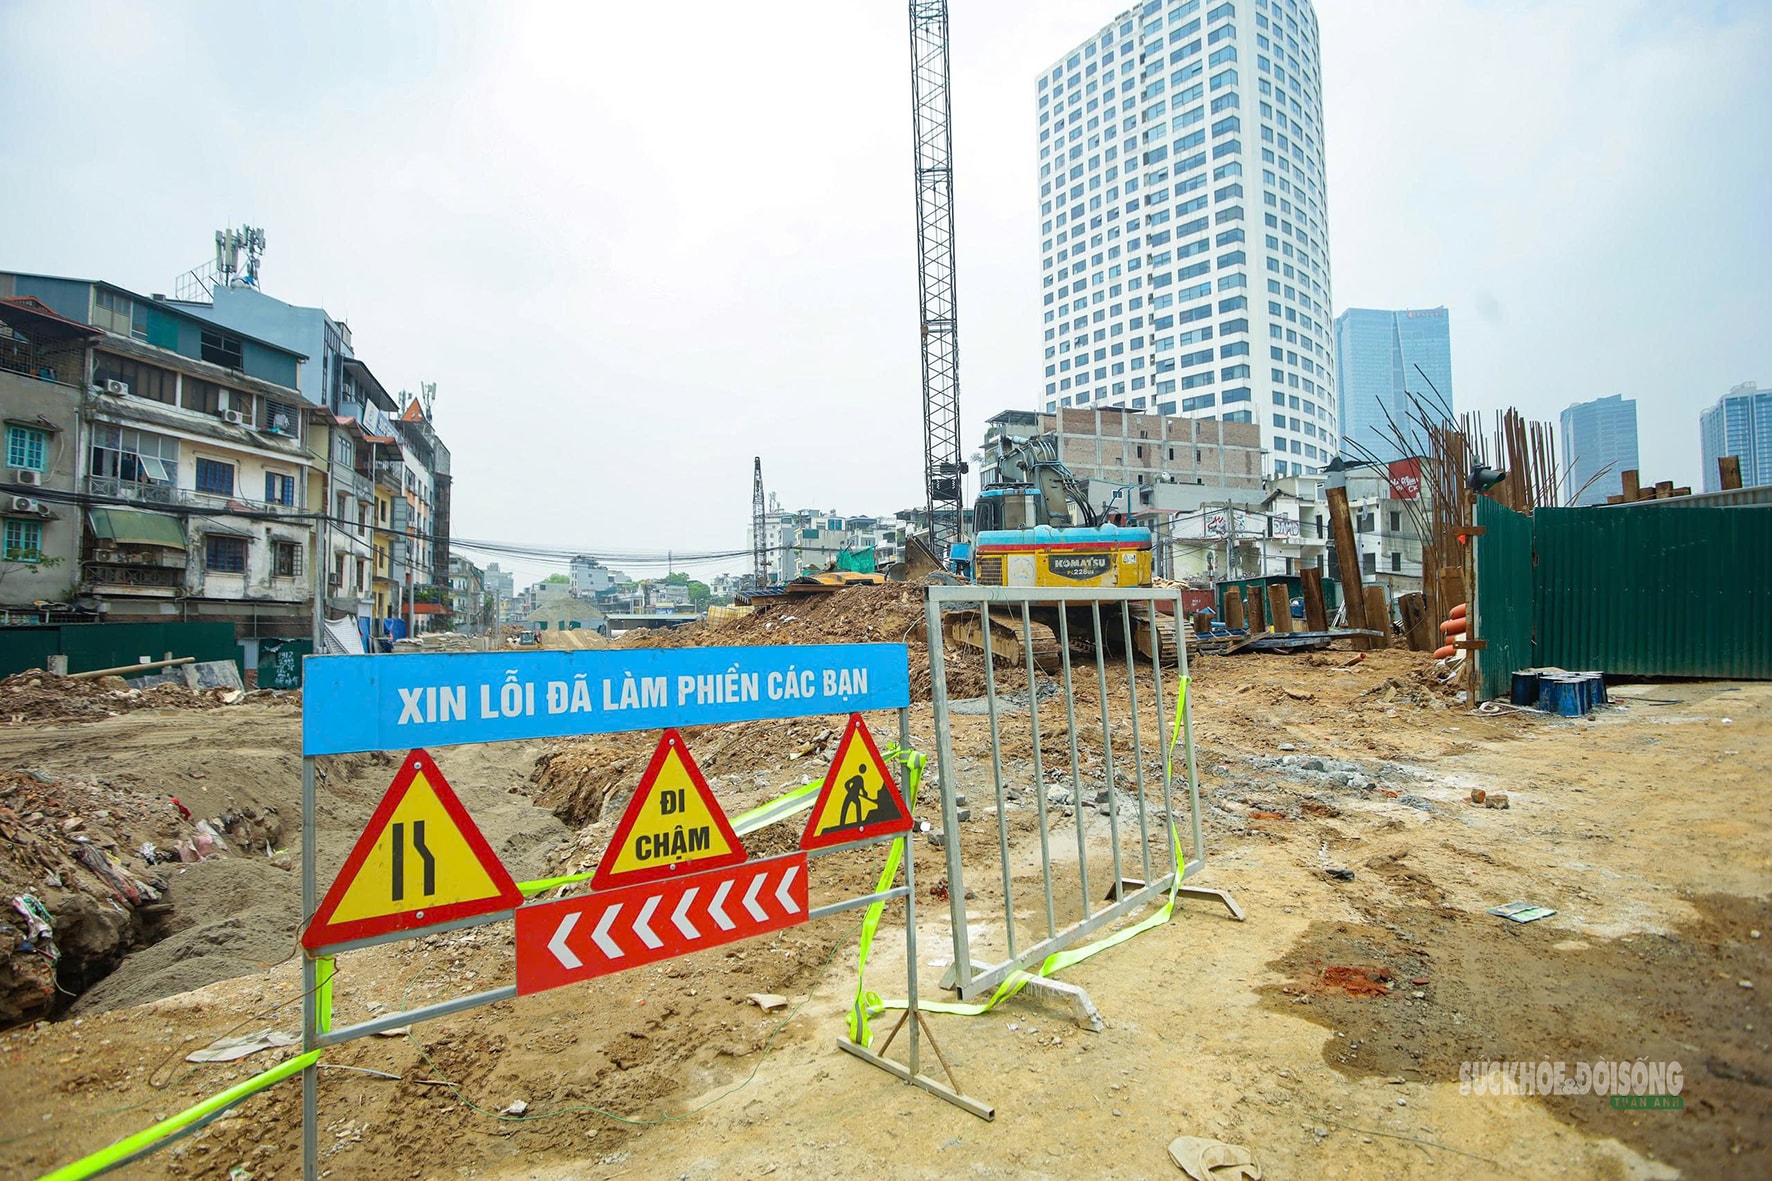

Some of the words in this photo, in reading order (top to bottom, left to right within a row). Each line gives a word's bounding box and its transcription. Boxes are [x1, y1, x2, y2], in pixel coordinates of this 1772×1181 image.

[1054, 557, 1106, 568] KOMATSU
[397, 685, 467, 725] XIN
[480, 669, 535, 719] LỖI
[546, 673, 592, 715] ĐÃ
[602, 671, 668, 711] LÀM
[678, 662, 759, 706] PHIỀN
[767, 665, 815, 700] CÁC
[823, 667, 868, 702] BẠN
[660, 788, 685, 815] ĐI
[635, 825, 710, 861] CHẬM
